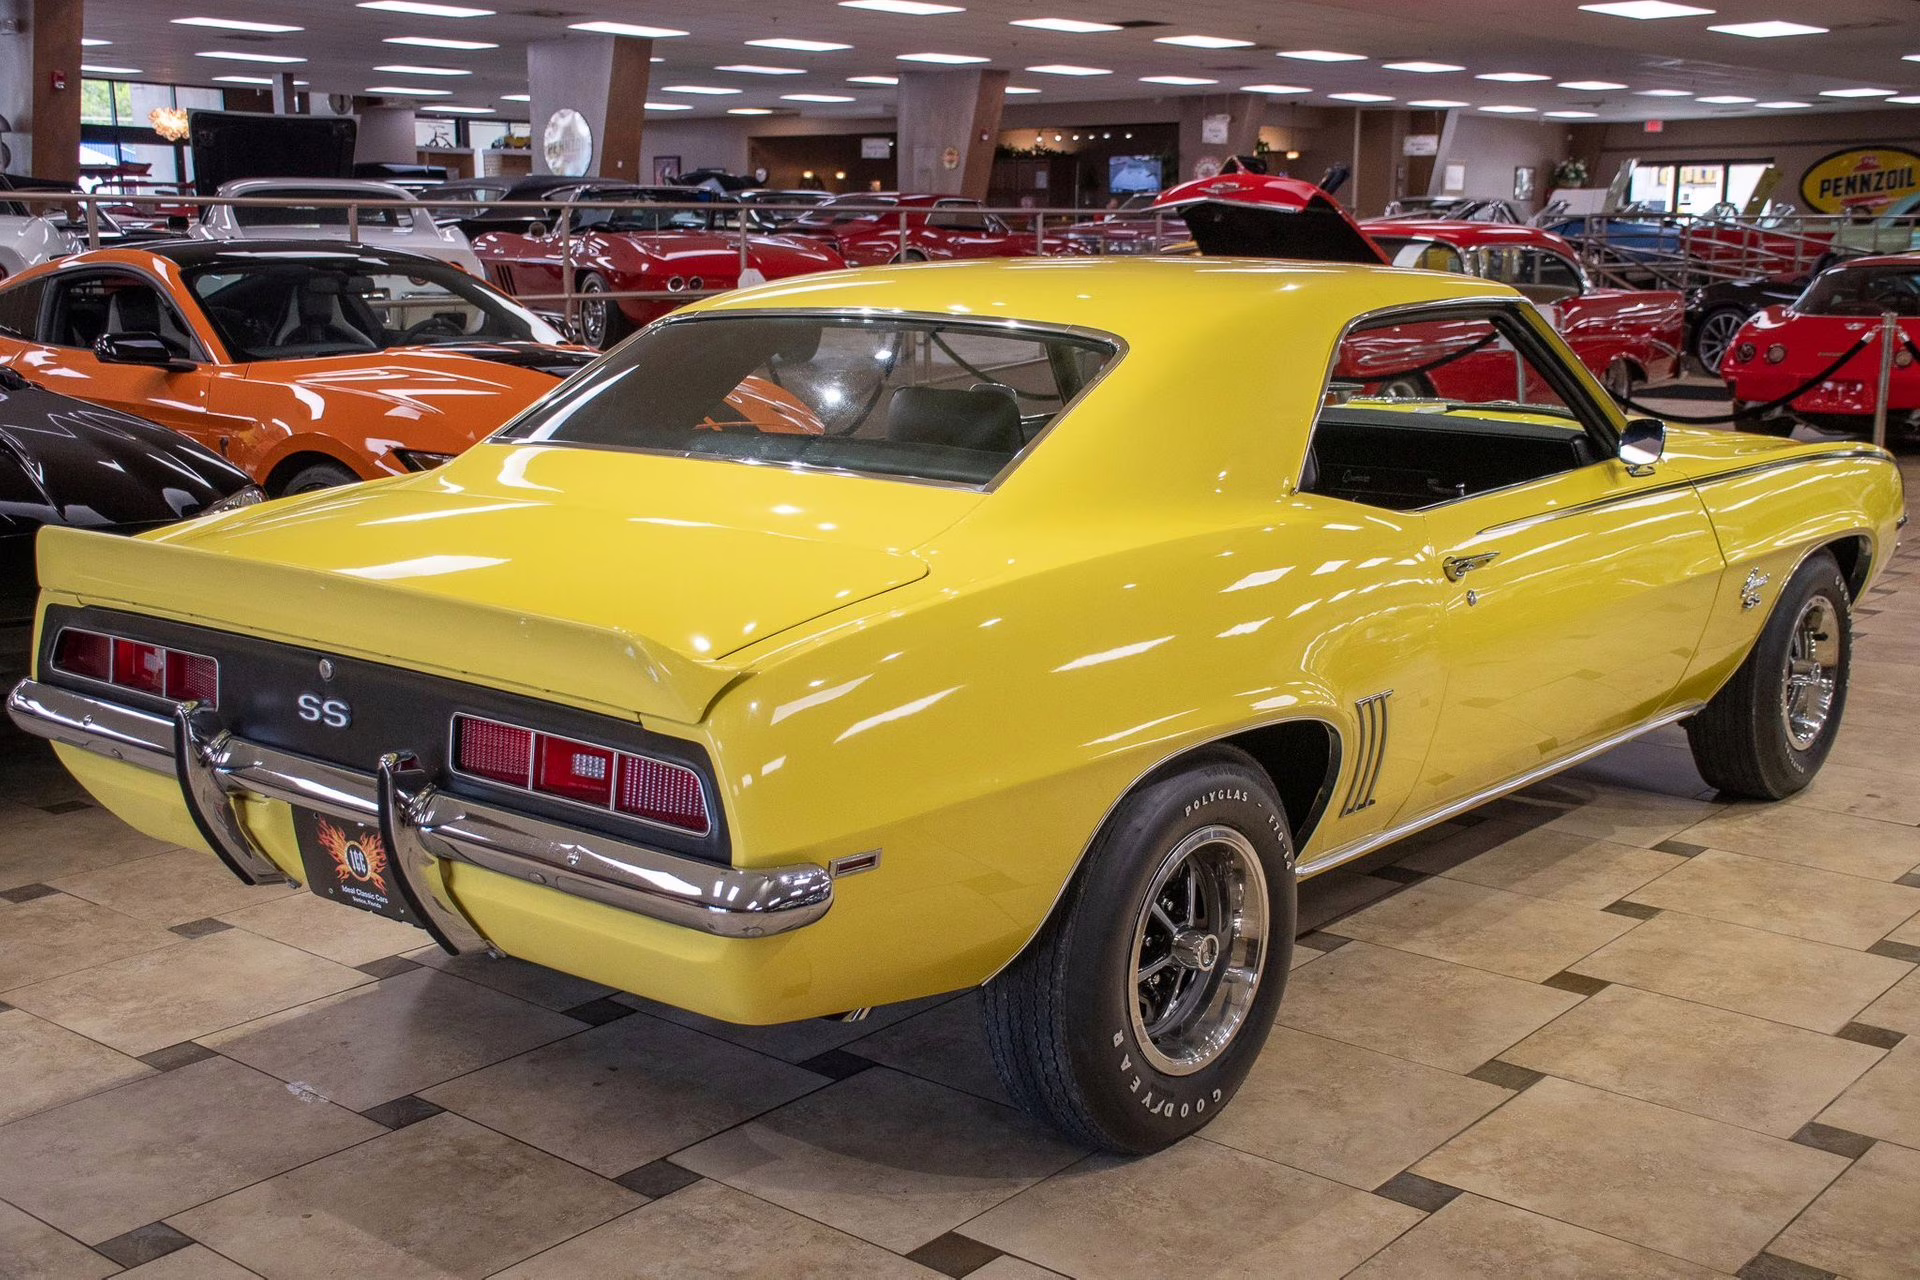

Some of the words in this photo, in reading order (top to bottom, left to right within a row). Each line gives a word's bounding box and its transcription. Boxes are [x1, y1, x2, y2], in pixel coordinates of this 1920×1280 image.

[1819, 167, 1916, 199] PENNZOIL
[298, 695, 347, 727] SS
[1185, 789, 1248, 817] POLYGLAS
[341, 884, 355, 894] Ideal
[356, 888, 375, 900] Classic
[375, 894, 389, 904] Cars
[1113, 1029, 1222, 1118] GOODYEAR
